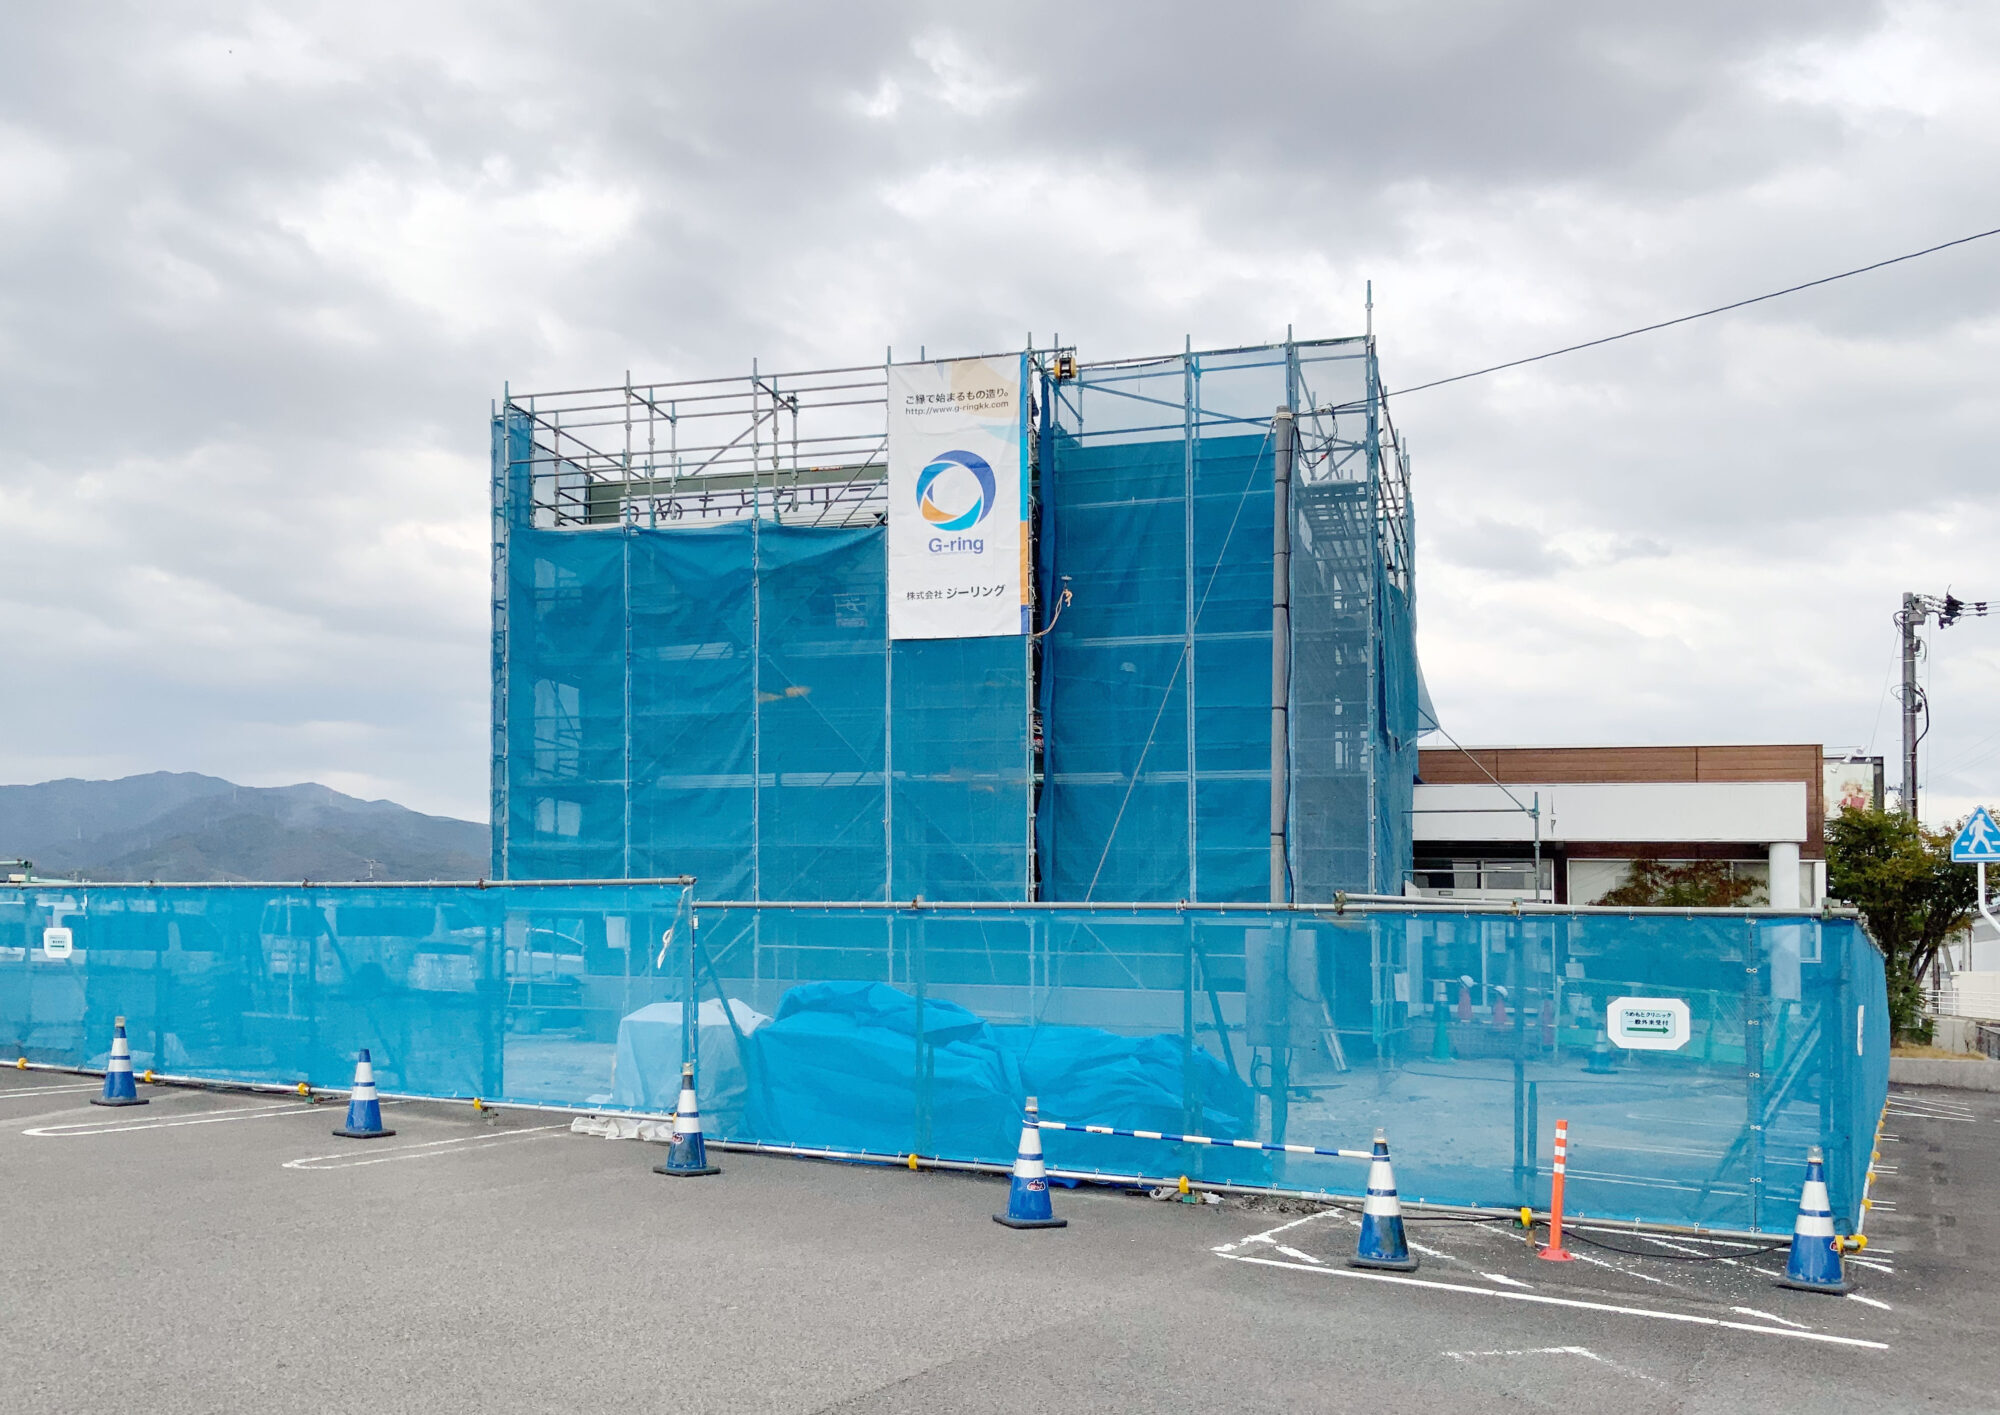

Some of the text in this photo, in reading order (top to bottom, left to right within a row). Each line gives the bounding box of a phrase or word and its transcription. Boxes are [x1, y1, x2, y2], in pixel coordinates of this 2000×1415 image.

[905, 388, 1009, 405] ご縁で始まるもの造り。
[905, 401, 1009, 416] http://www.g-ringkk.com
[928, 537, 984, 555] G-ring
[906, 584, 1006, 601] 株式会社 ジーリング
